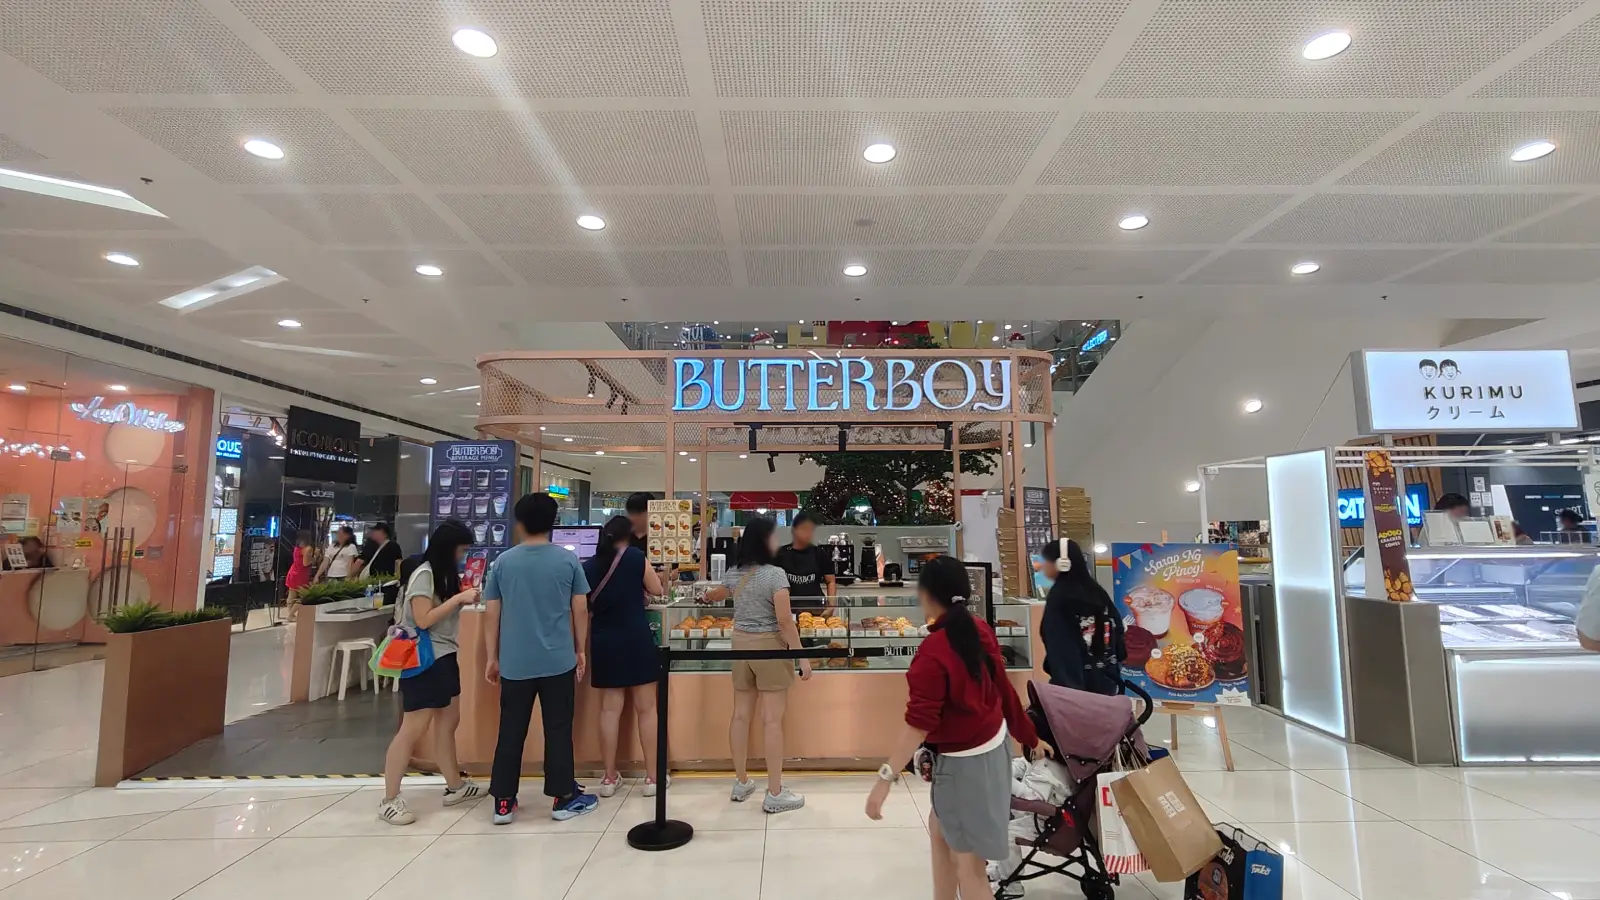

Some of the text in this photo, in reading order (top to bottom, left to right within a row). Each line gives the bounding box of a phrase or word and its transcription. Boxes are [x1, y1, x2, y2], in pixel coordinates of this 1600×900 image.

[672, 358, 1012, 412] BUTTERBOY
[1424, 385, 1523, 400] KURIMU
[1427, 405, 1505, 420] クリーム
[451, 446, 498, 456] BUTTERBOY
[1378, 529, 1402, 539] ADOBO
[1144, 549, 1202, 575] Sarap Ng
[1163, 561, 1205, 582] Pinoy!
